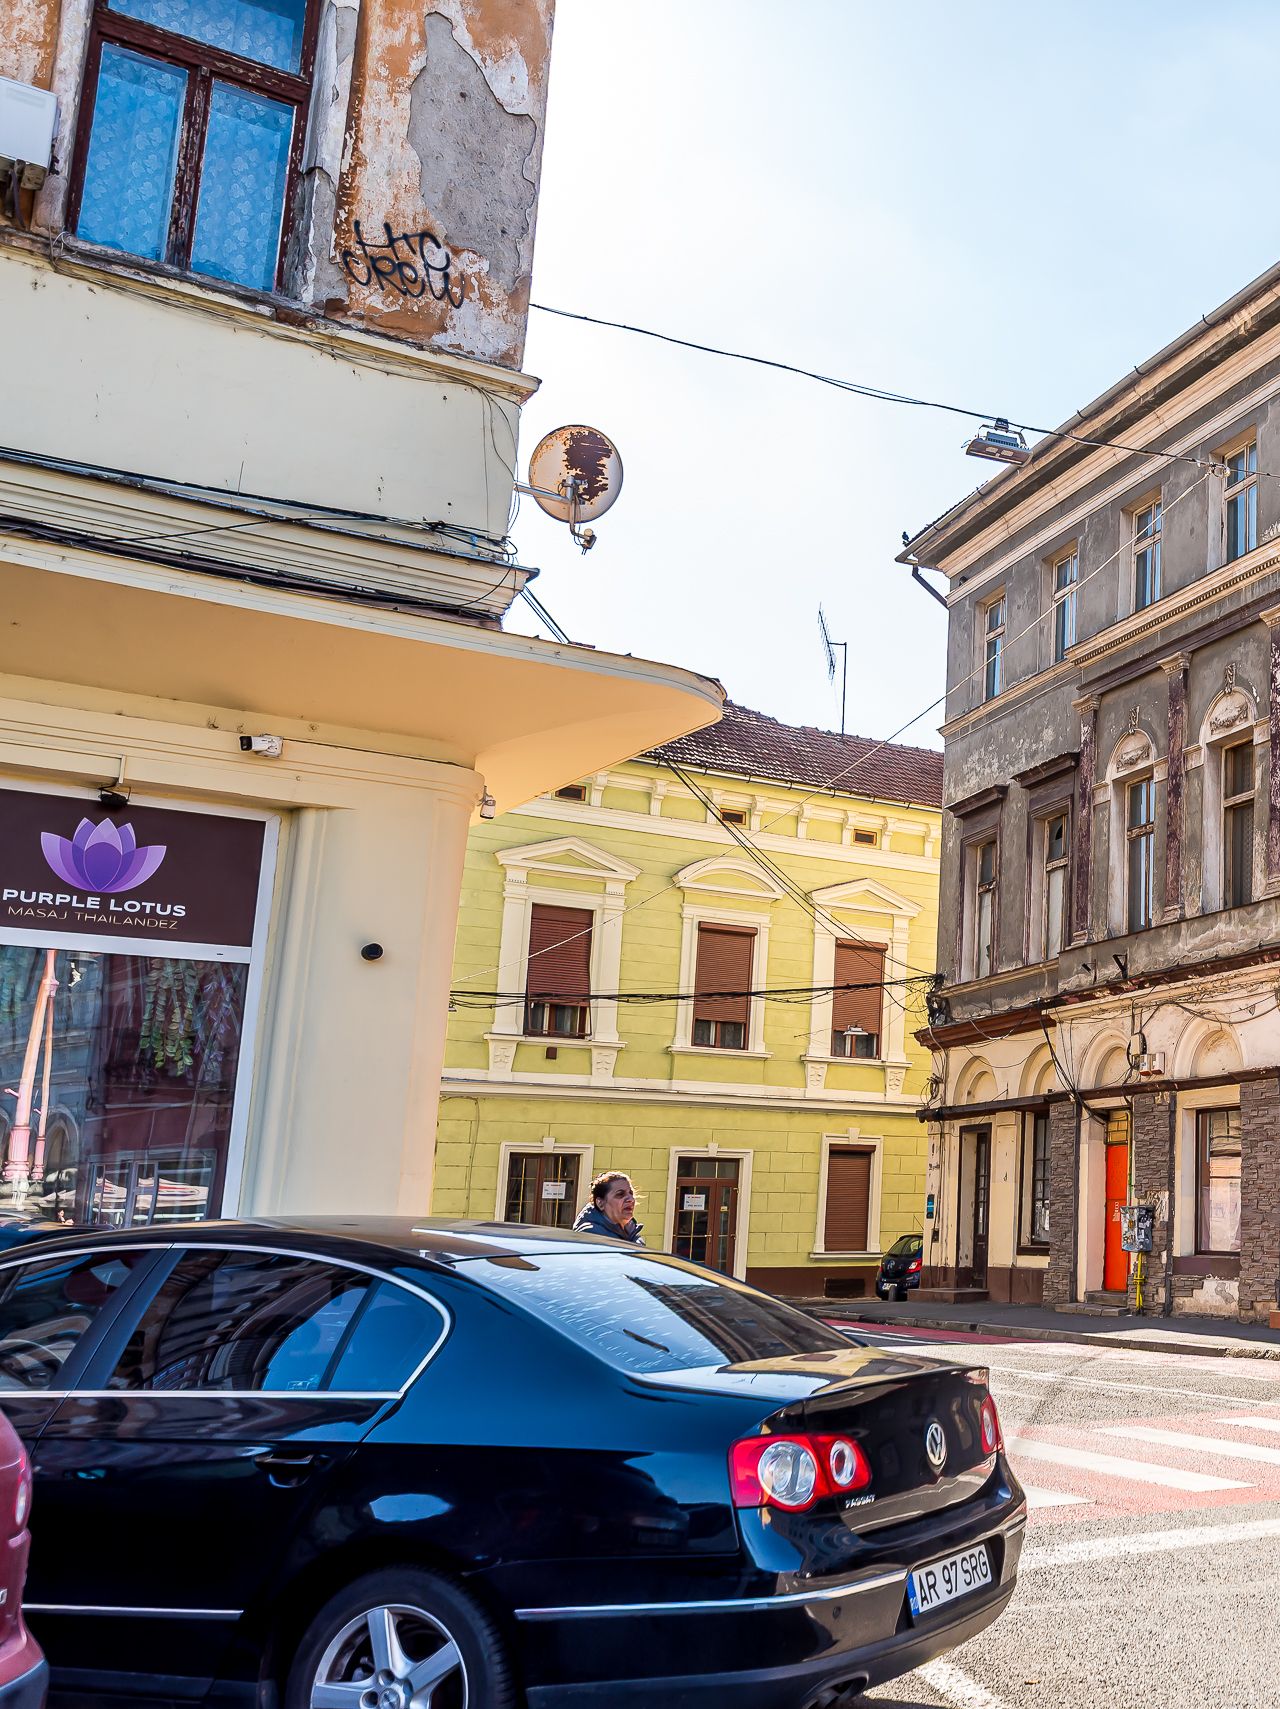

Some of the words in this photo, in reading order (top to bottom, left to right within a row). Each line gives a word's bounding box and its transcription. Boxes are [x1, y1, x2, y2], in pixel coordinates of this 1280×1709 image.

[3, 888, 101, 910] PURPLE
[109, 898, 187, 917] LOTUS
[7, 906, 68, 920] MASAJ
[74, 911, 178, 930] THAILANDEZ
[918, 1569, 941, 1608] AR
[941, 1559, 958, 1595] 97
[960, 1549, 989, 1587] SRG
